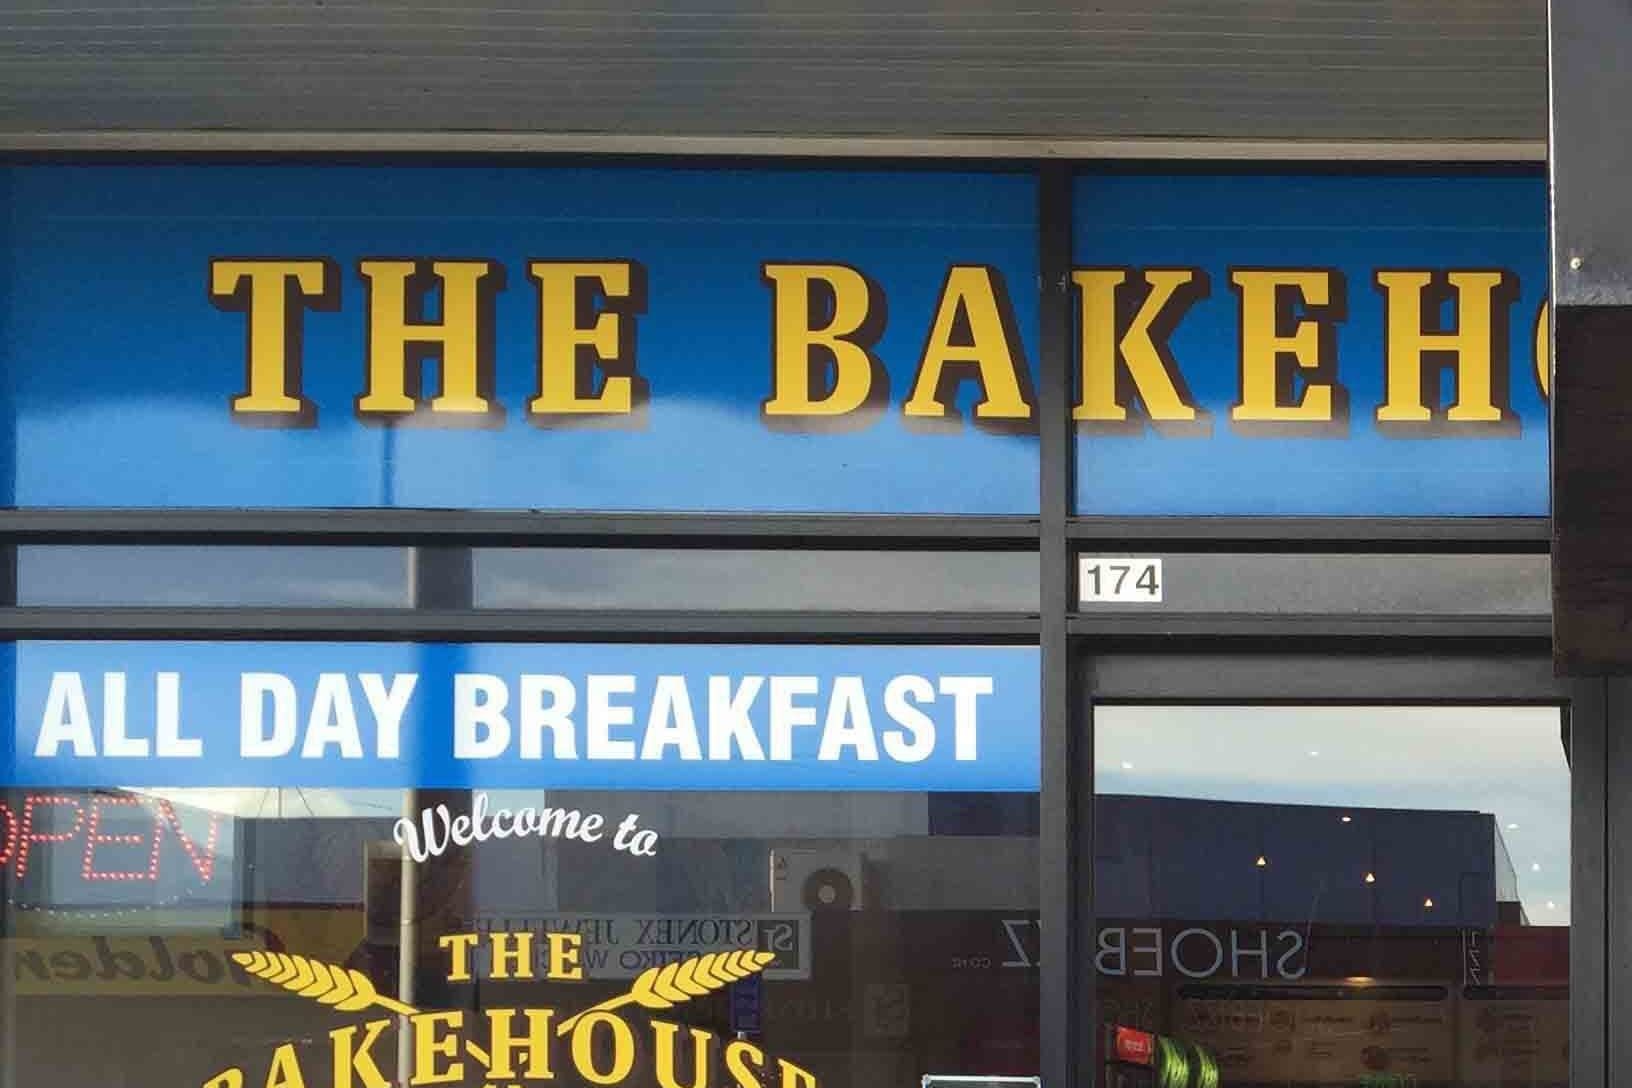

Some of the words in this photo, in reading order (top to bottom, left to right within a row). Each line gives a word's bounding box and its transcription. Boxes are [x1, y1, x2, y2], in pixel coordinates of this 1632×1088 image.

[210, 257, 648, 428] THE
[1087, 564, 1159, 597] 174
[35, 671, 203, 758] ALL
[239, 673, 419, 760] DAY
[452, 673, 994, 763] BREAKFAST
[393, 792, 603, 863] Welcome
[612, 813, 659, 857] to
[440, 932, 585, 982] THE
